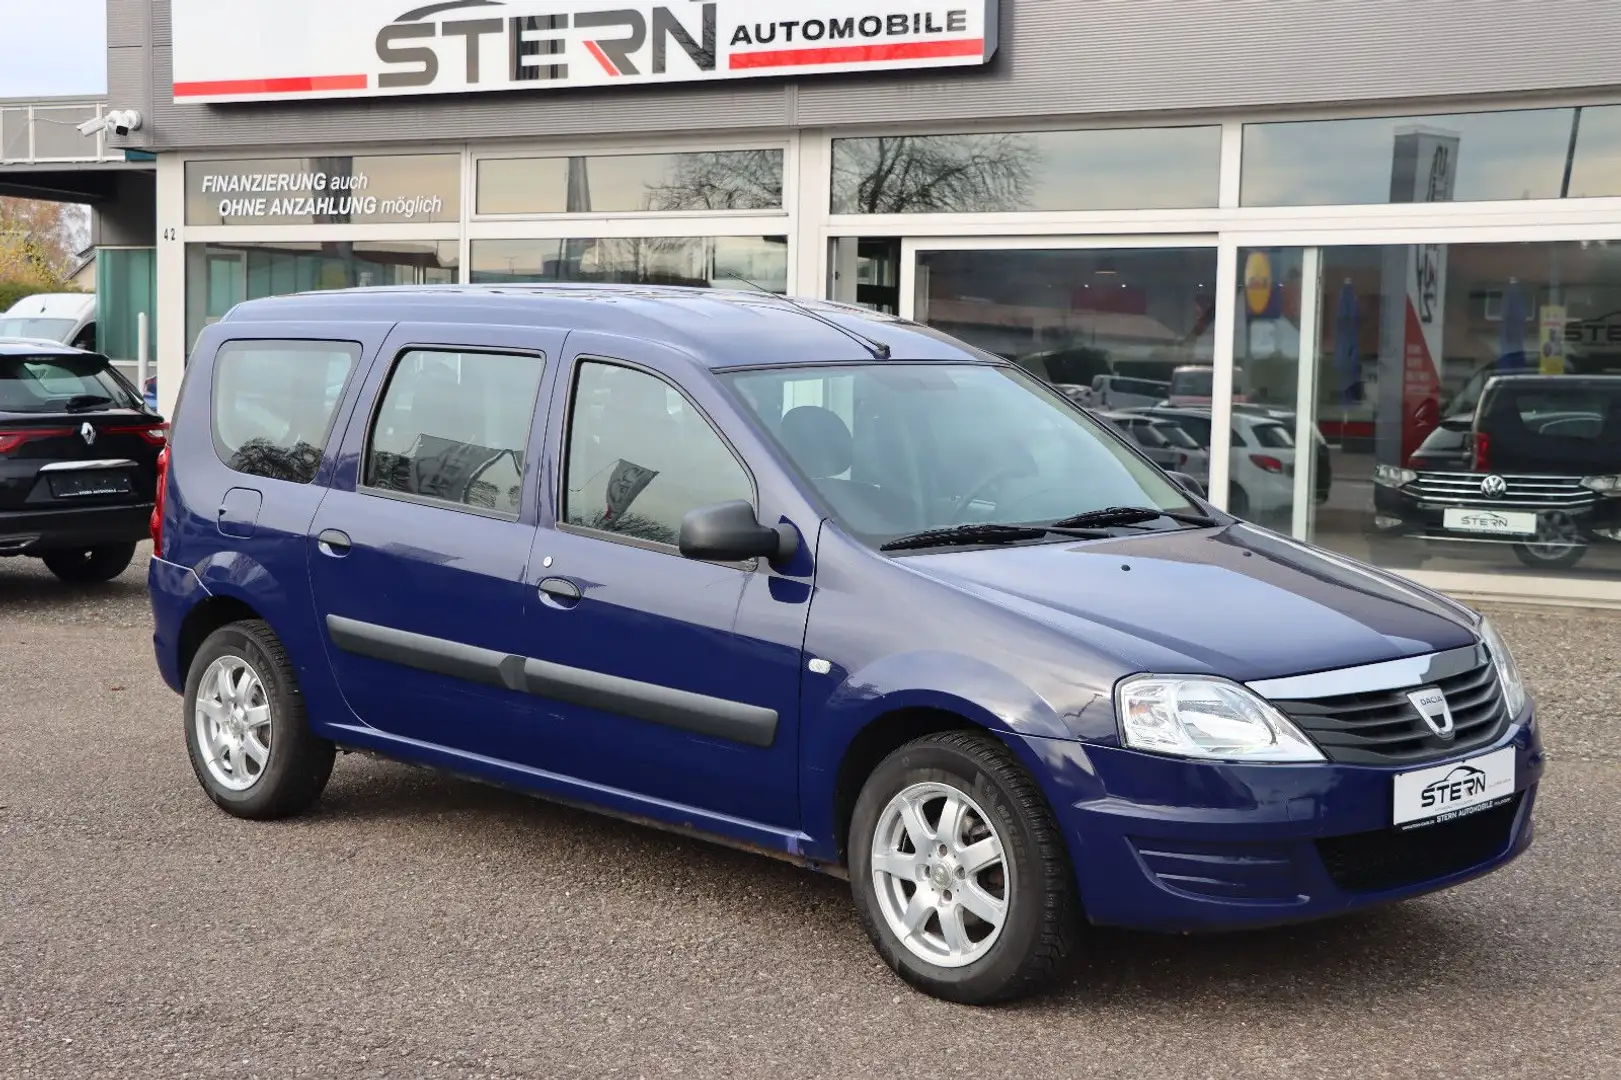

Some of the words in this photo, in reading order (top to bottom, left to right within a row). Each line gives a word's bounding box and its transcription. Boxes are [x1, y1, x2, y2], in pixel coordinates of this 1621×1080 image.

[375, 2, 717, 88] STERN
[730, 9, 967, 46] AUTOMOBILE
[202, 173, 327, 193] FINANZIERUNG
[331, 172, 368, 190] auch
[218, 198, 265, 216] OHNE
[270, 196, 376, 215] ANZAHLUNG
[381, 195, 442, 218] möglich
[1461, 516, 1508, 527] STERN
[1420, 695, 1443, 706] DACIA
[1421, 774, 1486, 808] STERN
[1436, 812, 1457, 823] STERN
[1458, 801, 1493, 816] AUTOMOBILE
